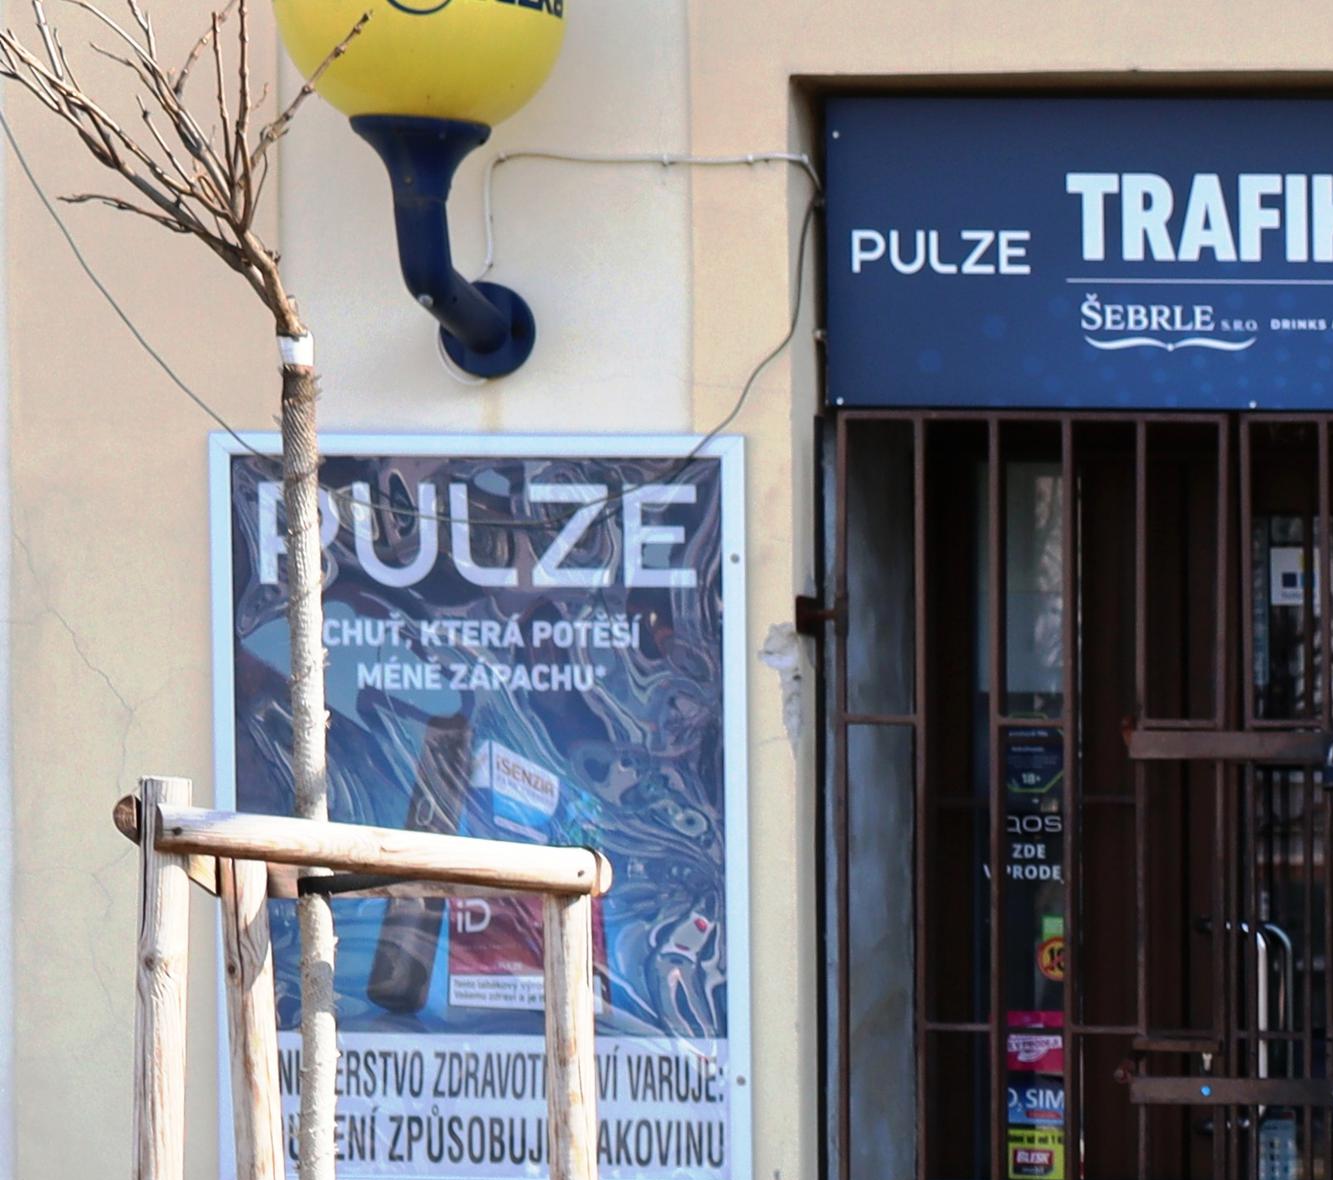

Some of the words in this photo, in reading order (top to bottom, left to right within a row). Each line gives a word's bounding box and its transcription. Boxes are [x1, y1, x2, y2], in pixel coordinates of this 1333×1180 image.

[852, 229, 1031, 275] PULZE
[1081, 293, 1215, 331] ŠEBRLE
[1271, 319, 1327, 331] DRINKS
[258, 481, 697, 588] PULZE
[322, 613, 413, 651] CHUŤ,
[420, 612, 525, 650] KTERÁ
[533, 611, 641, 650] POTĚŠÍ
[357, 656, 445, 691] MÉNĚ
[1007, 815, 1063, 834] QOS
[1012, 844, 1046, 858] ZDE
[628, 1054, 724, 1102] VARUJE:
[597, 1118, 724, 1168] AKOVINU
